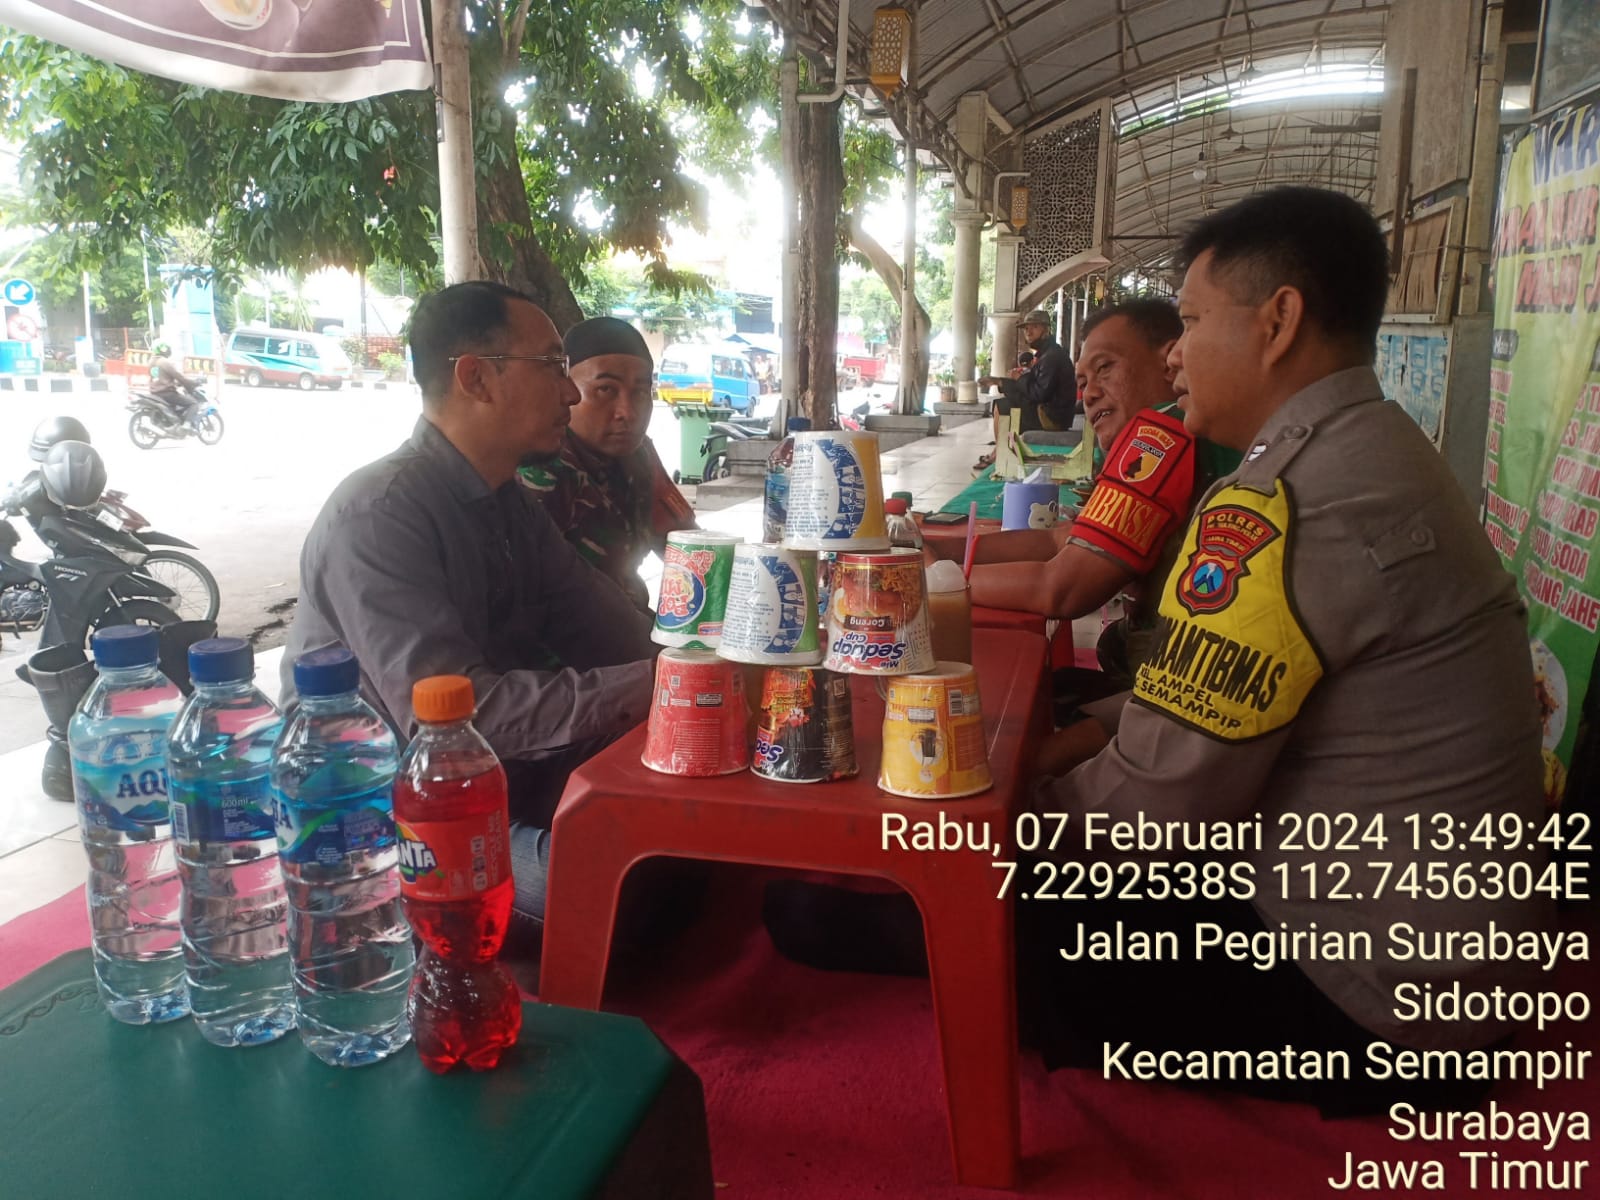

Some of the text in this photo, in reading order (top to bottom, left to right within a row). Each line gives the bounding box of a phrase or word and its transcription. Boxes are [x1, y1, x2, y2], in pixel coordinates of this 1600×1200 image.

[1208, 513, 1265, 537] POLRES
[54, 565, 87, 576] HONDA
[1552, 539, 1590, 582] SODA
[849, 616, 886, 627] Goreng
[1560, 588, 1600, 633] JAHE
[1157, 674, 1215, 707] AMPEL
[1140, 681, 1242, 729] SEMAMPIR
[221, 798, 248, 808] 600ml
